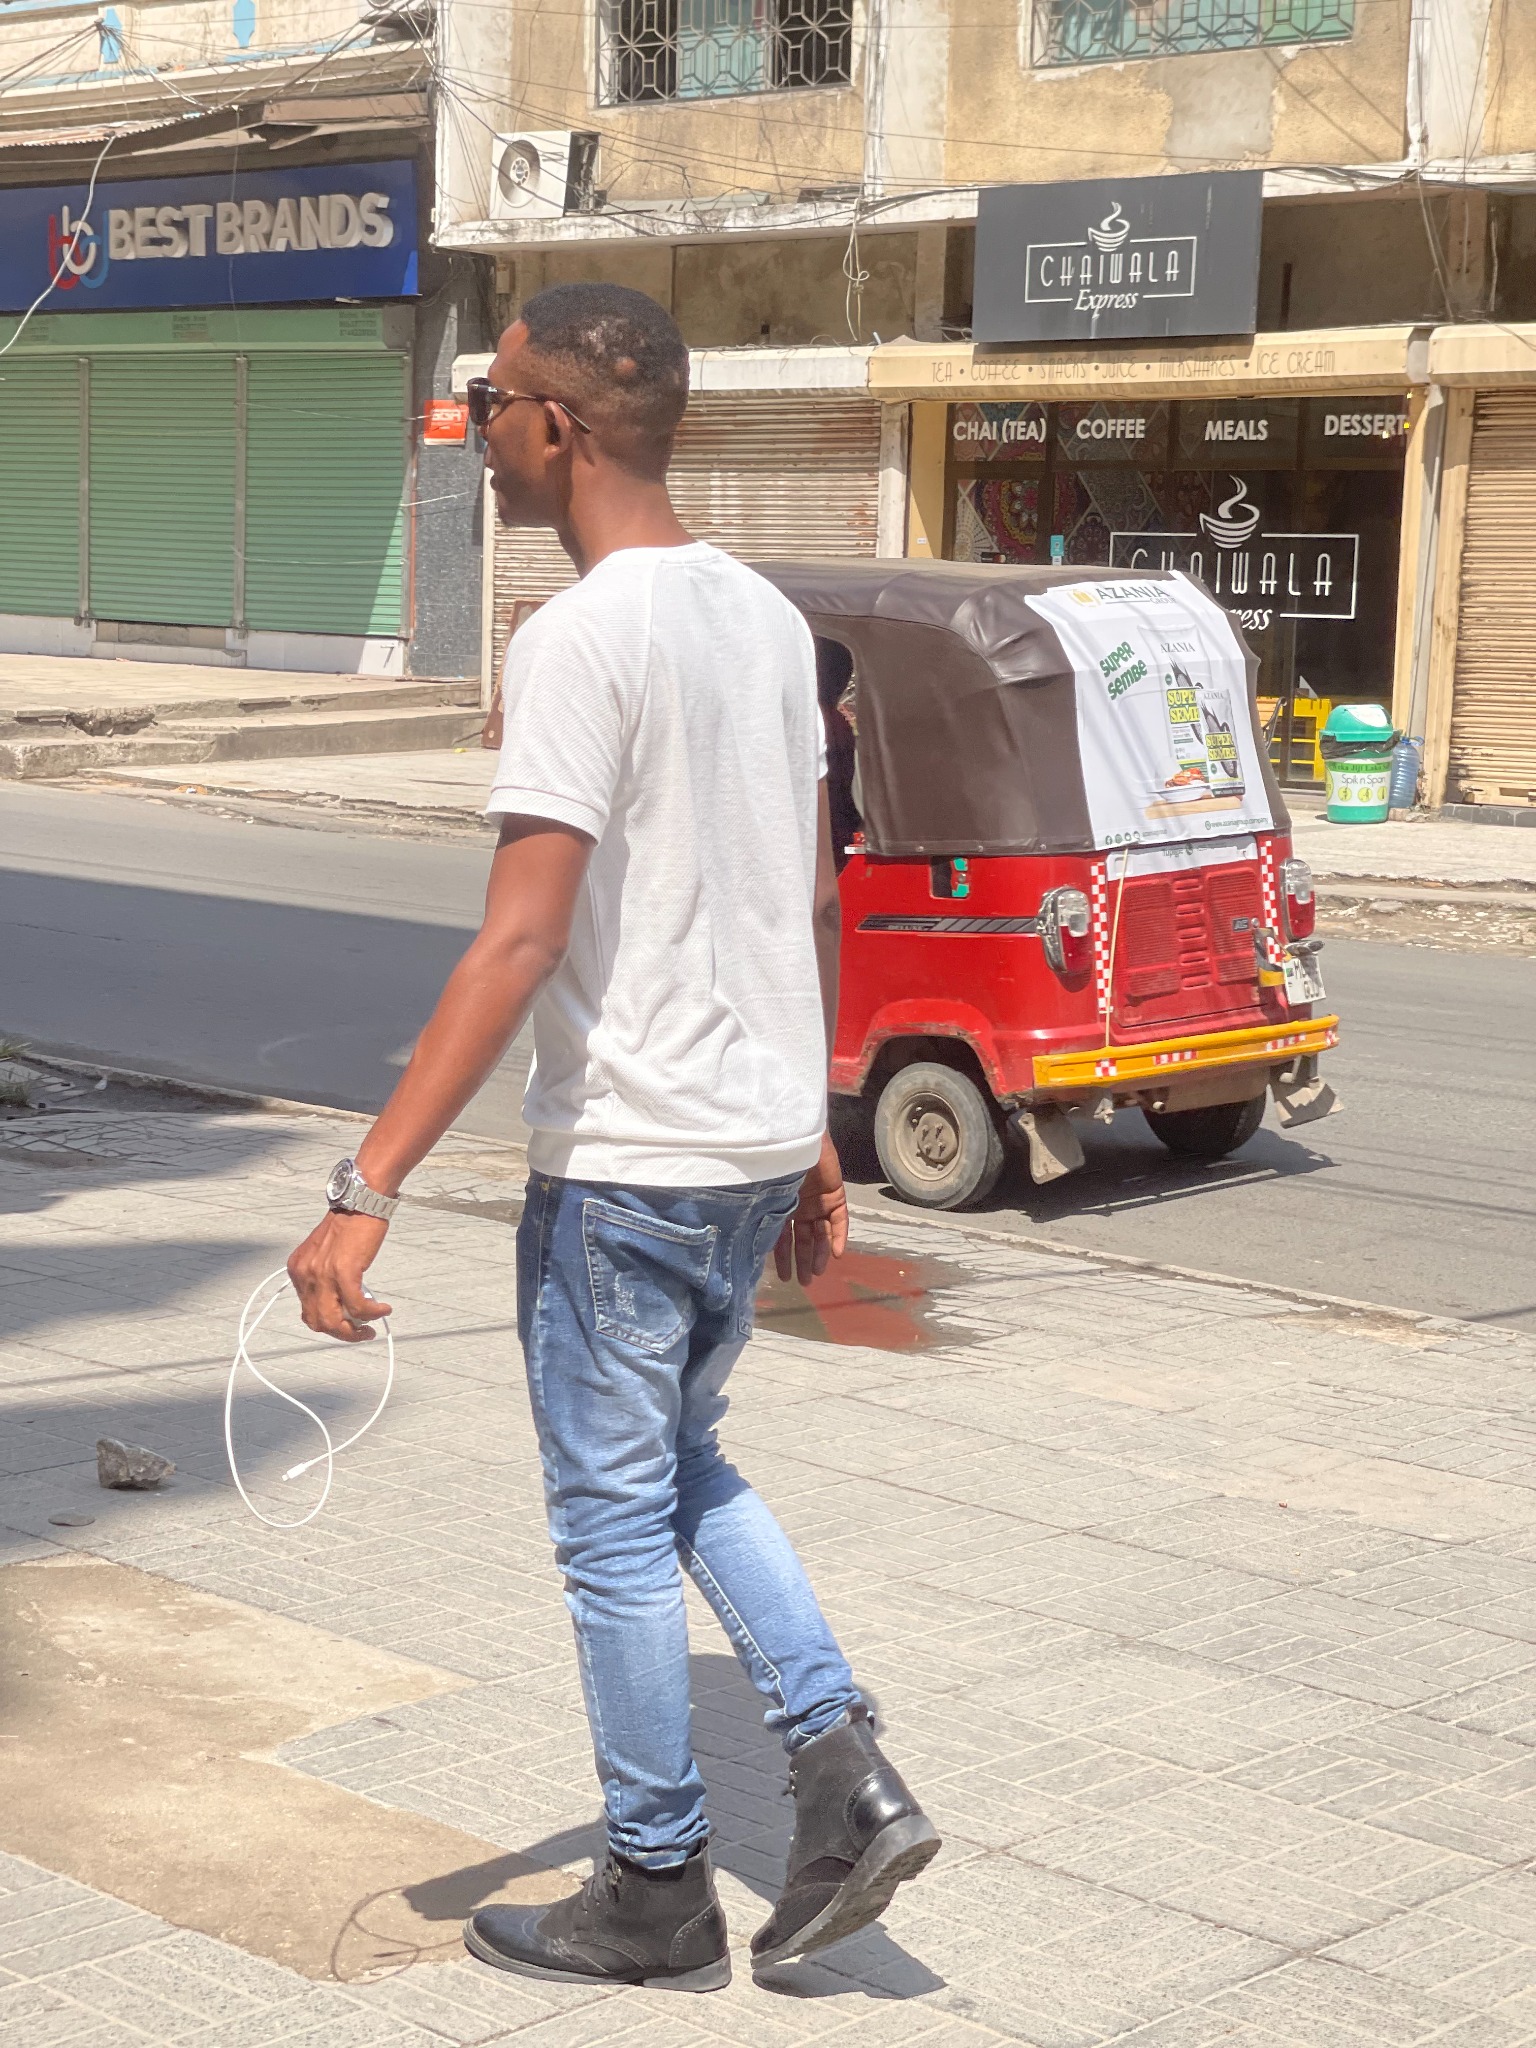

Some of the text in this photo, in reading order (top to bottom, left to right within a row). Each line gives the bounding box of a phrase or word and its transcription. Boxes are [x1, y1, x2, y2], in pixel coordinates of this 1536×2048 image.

[108, 192, 394, 261] BEST BRANDS
[1040, 250, 1180, 287] CHAIWALA
[1074, 289, 1139, 320] Express
[931, 350, 1336, 383] TEA COFFEE SNACKS JUICE MILKSHAKES ICE CREAM
[953, 418, 1047, 443] CHAI (TEA)
[1076, 418, 1146, 440] COFFEE
[1204, 419, 1269, 441] MEALS
[1095, 585, 1171, 600] AZANIA
[1160, 642, 1196, 653] AZANIA
